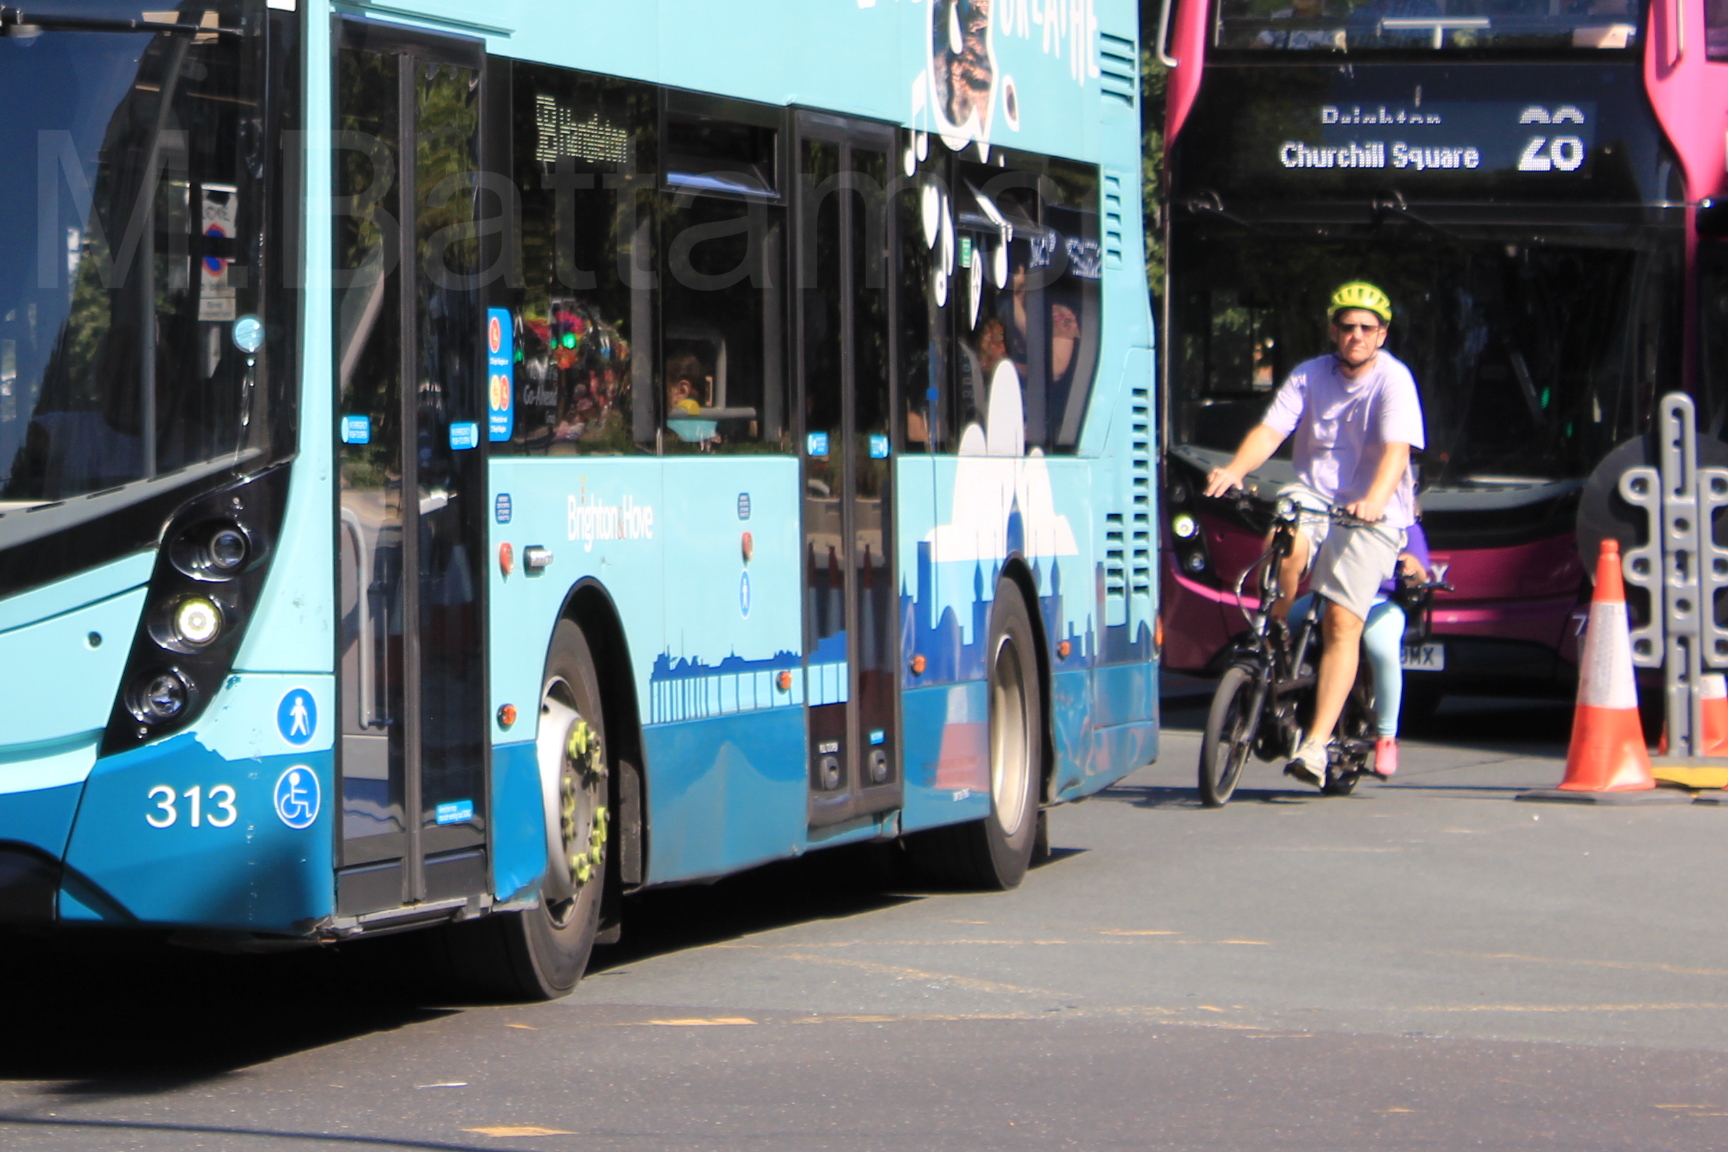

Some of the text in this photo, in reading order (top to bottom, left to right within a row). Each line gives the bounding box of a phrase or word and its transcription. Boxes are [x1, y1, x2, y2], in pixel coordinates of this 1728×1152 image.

[1279, 140, 1480, 171] Churchill Square
[145, 784, 238, 829] 313
